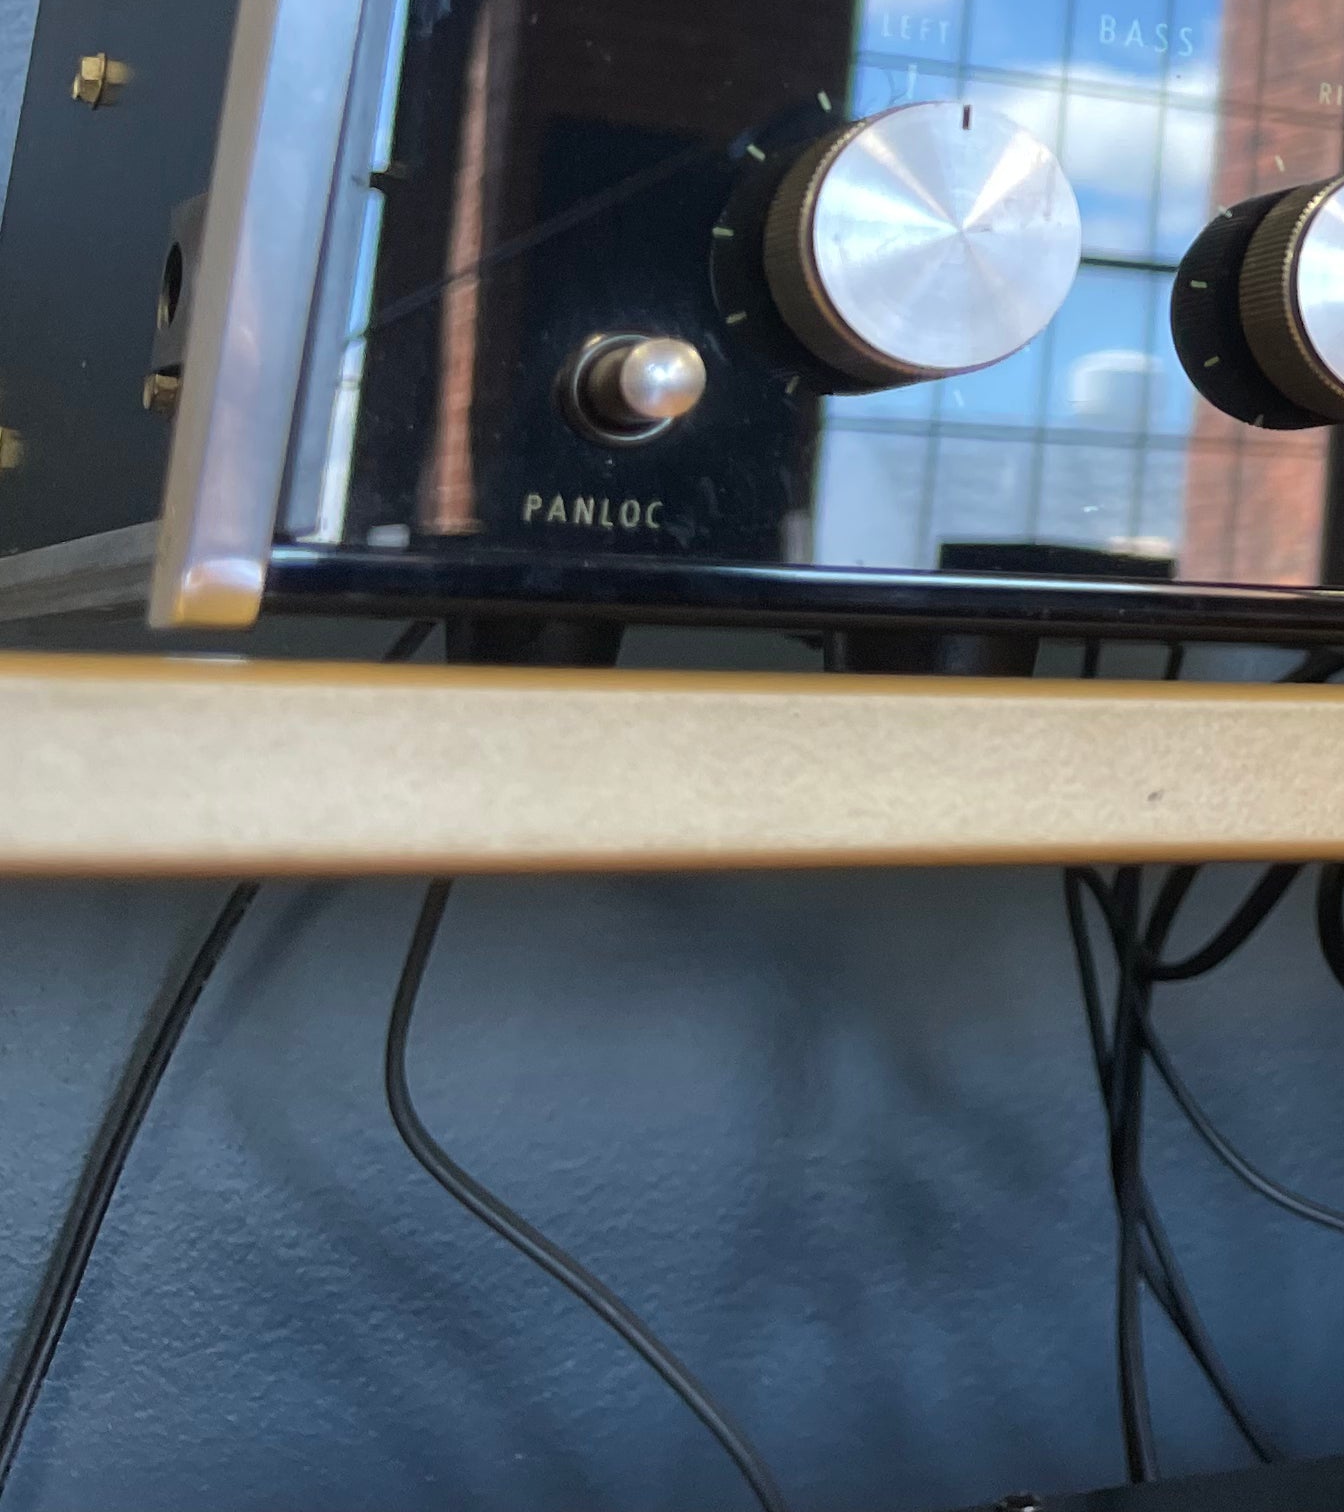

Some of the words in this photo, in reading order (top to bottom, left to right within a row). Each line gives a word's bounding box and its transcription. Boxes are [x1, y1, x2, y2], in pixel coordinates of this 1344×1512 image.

[880, 12, 951, 45] LEFT
[1100, 15, 1194, 57] BASS
[523, 492, 664, 530] PANLOC
